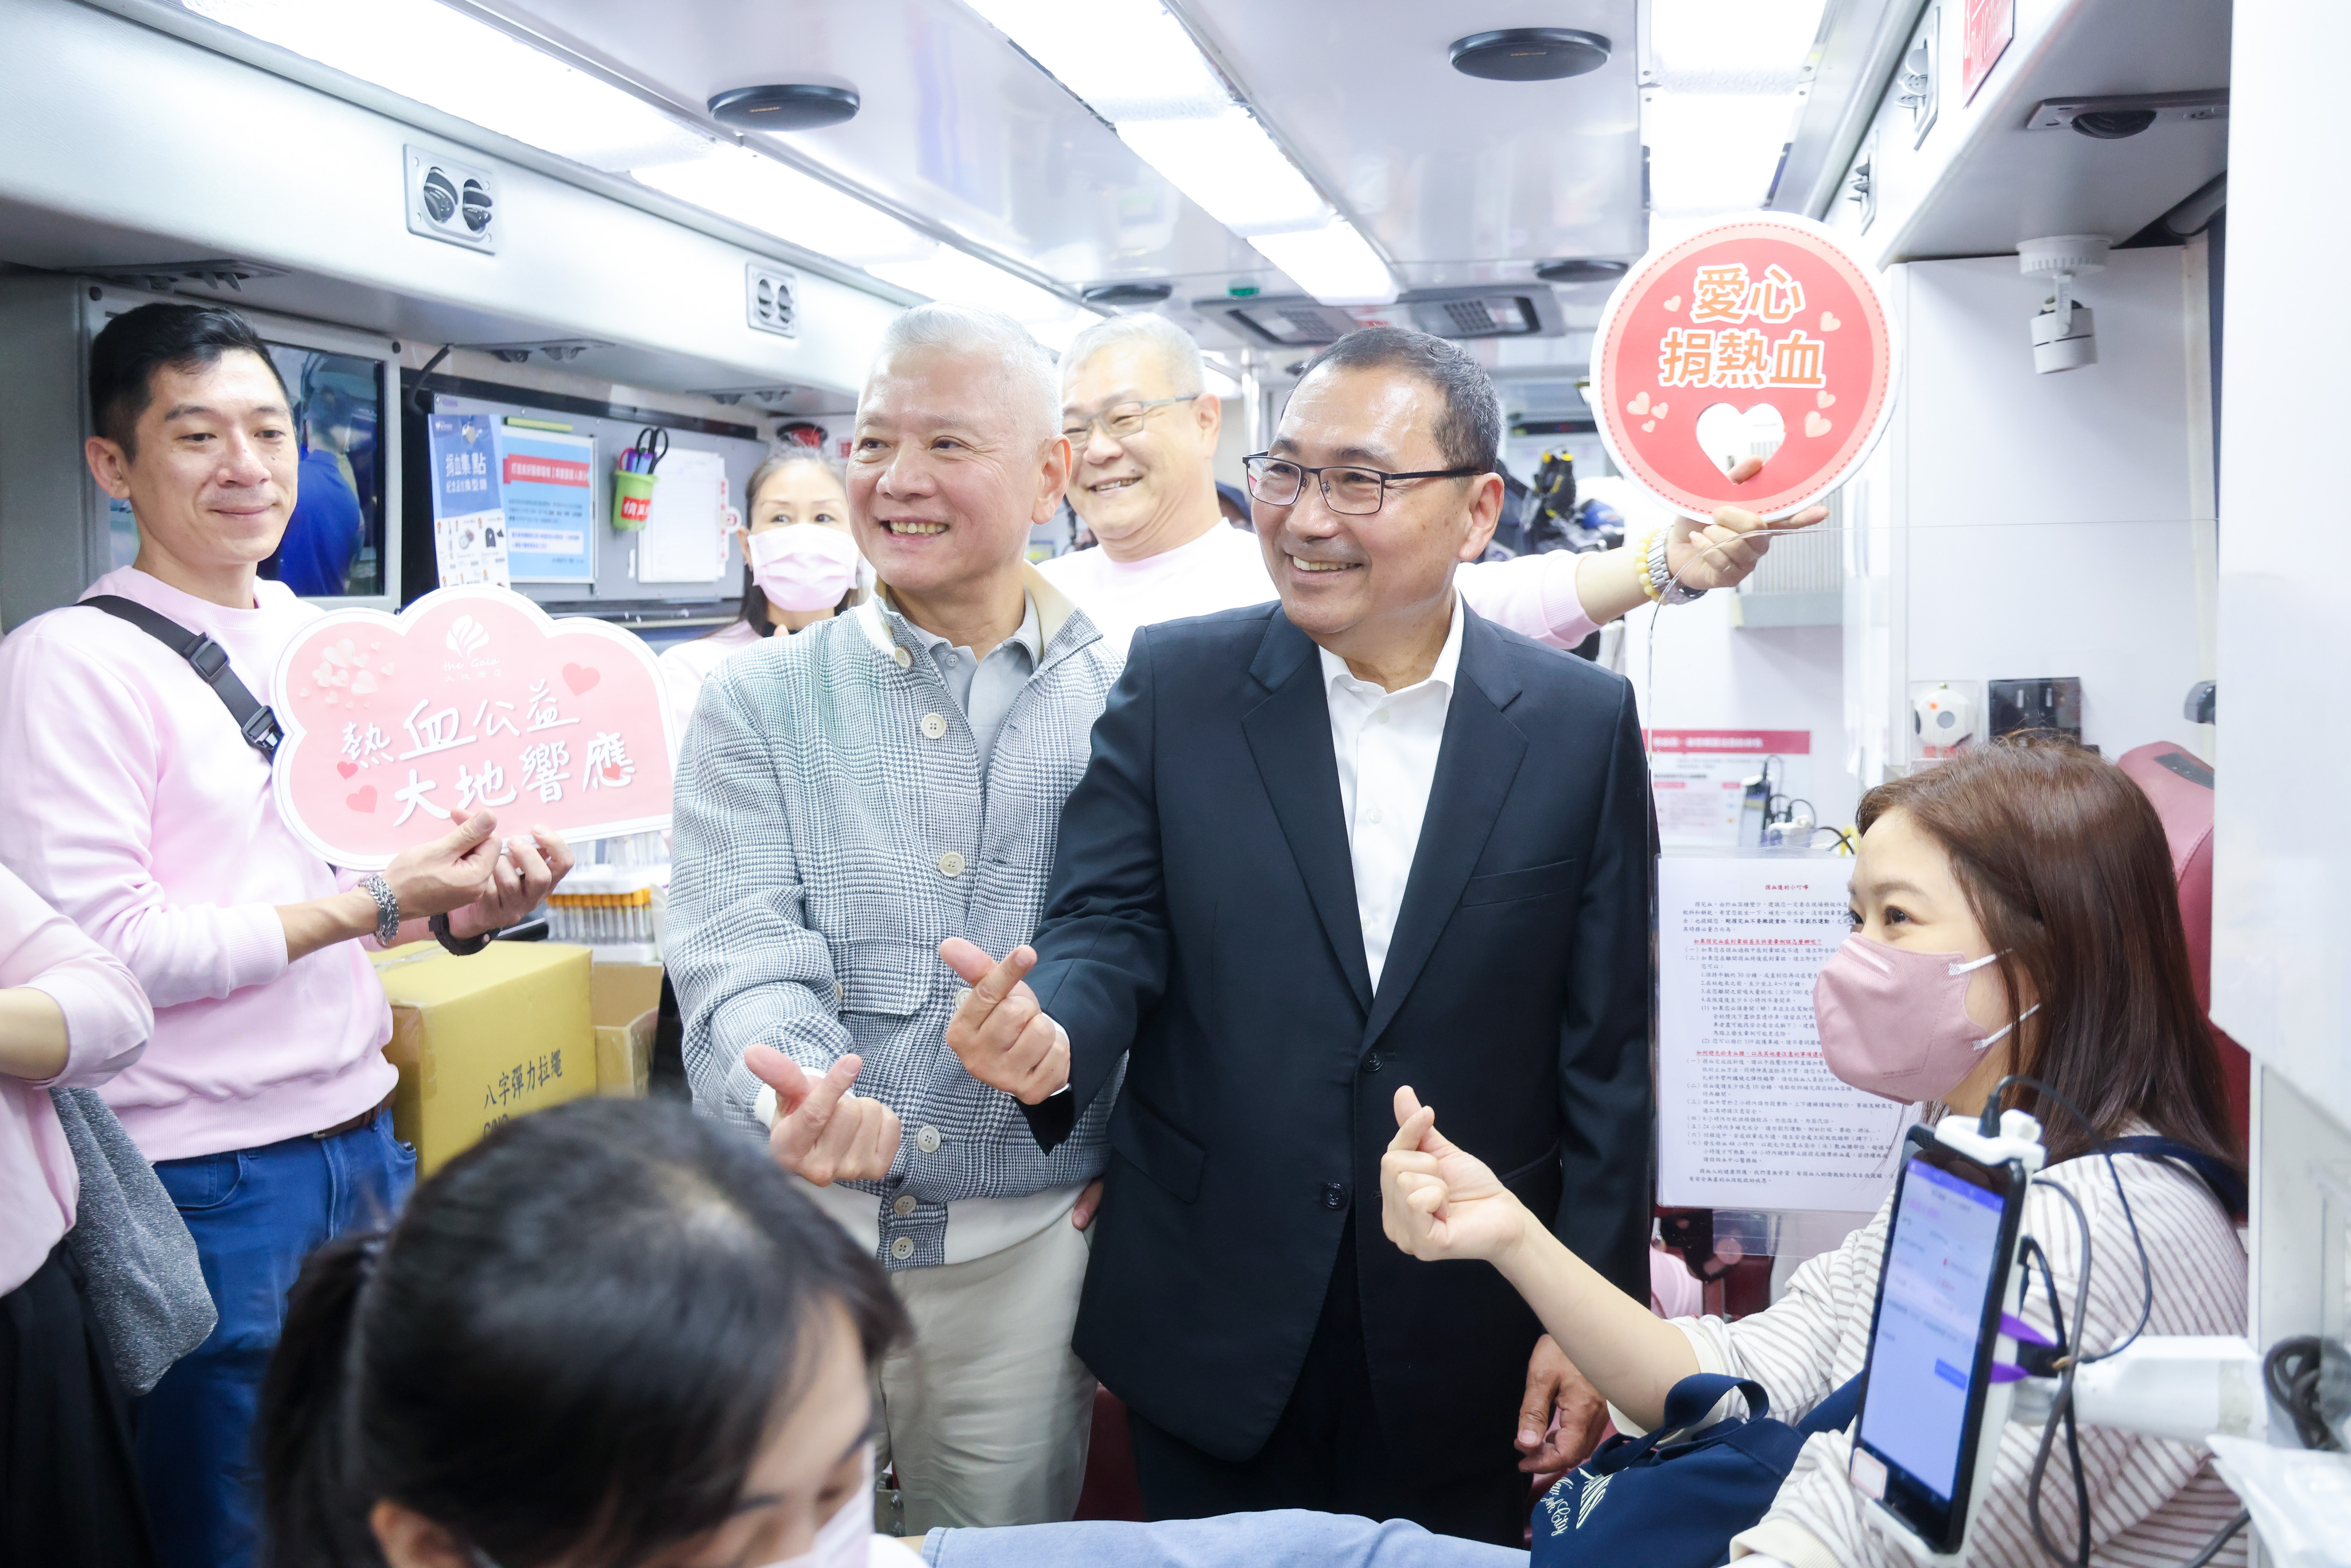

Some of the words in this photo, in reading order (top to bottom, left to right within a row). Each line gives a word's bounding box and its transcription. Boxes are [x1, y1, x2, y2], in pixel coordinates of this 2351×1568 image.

[1690, 263, 1805, 324] 愛心
[1658, 327, 1826, 389] 捐熱血
[443, 661, 464, 671] the
[471, 657, 501, 668] Gaia
[342, 678, 580, 769] 熱血公益
[393, 732, 635, 826] 大地響應
[484, 1049, 562, 1110] 八字彈力拉繩
